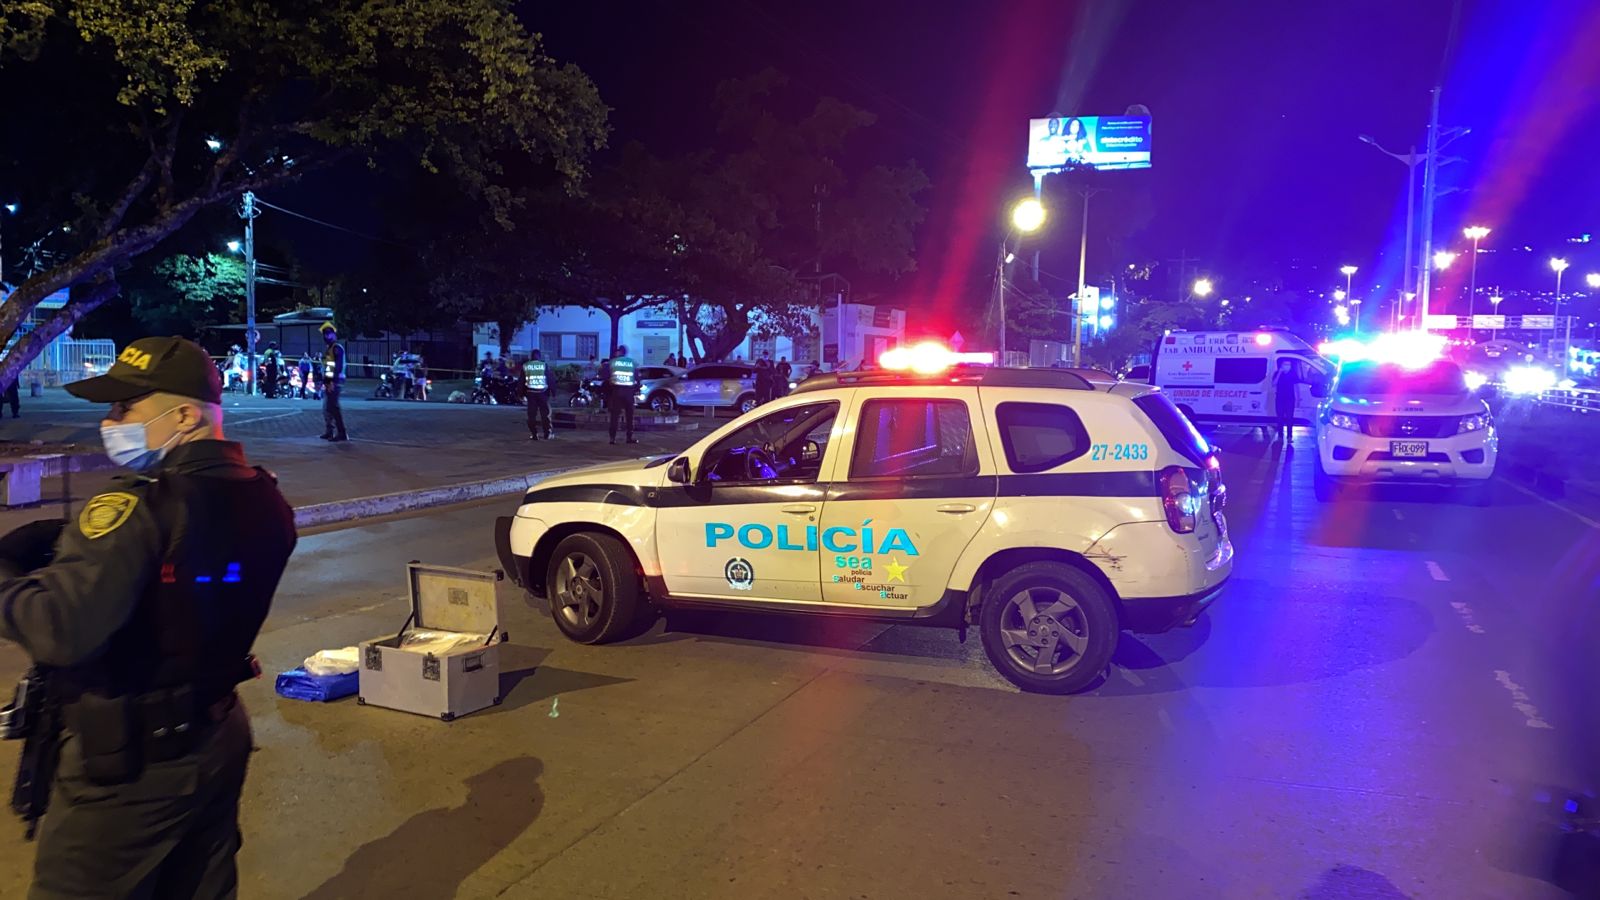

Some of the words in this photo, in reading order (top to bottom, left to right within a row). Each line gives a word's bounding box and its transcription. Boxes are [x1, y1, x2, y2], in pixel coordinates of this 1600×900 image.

[1183, 345, 1246, 354] AMBULANCIA
[1173, 390, 1200, 398] UNIDAD
[1201, 390, 1212, 398] DE
[1214, 390, 1248, 399] RESCATE
[1092, 443, 1148, 461] 27-2433
[704, 518, 919, 556] POLICÍA
[834, 555, 873, 570] sea
[832, 575, 865, 584] saludar
[854, 582, 896, 592] escuchar
[880, 591, 909, 600] actuar
